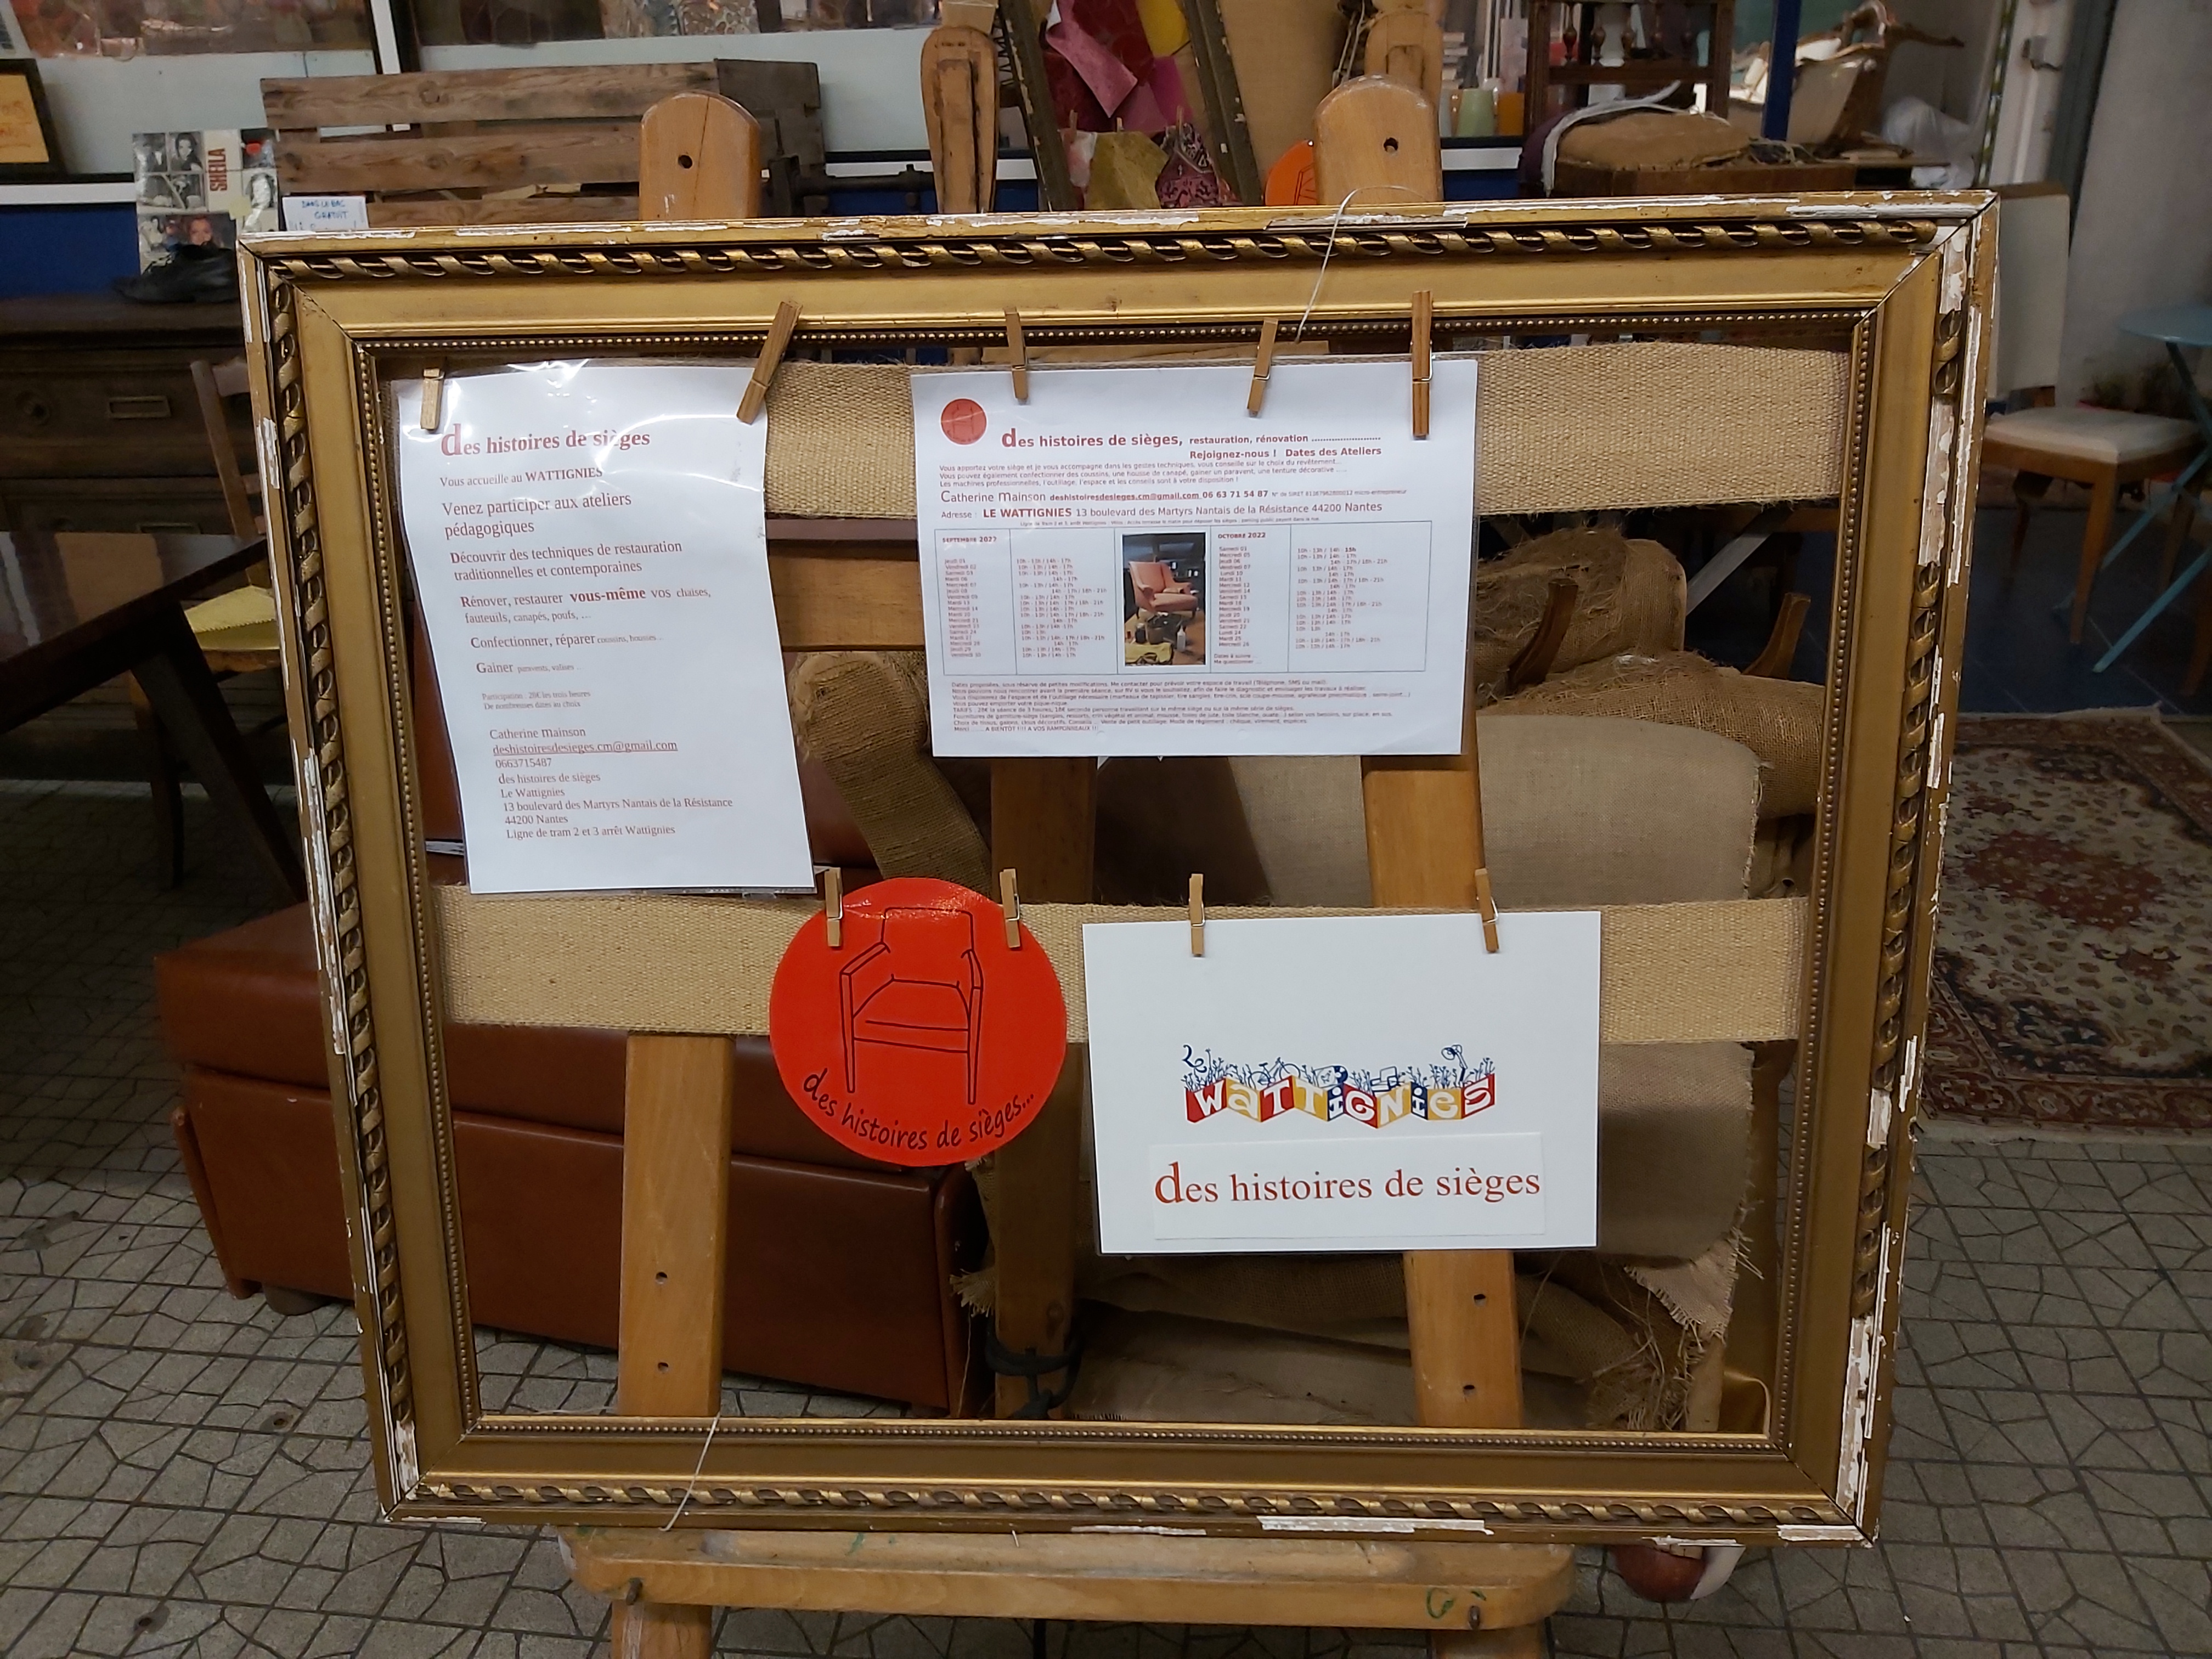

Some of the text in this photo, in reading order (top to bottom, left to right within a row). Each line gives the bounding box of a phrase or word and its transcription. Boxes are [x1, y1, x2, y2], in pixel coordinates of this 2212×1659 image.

[208, 148, 227, 191] SHEILA
[441, 423, 481, 456] des
[486, 433, 560, 454] histoires
[566, 430, 587, 448] de
[1001, 428, 1034, 448] des
[1040, 435, 1103, 447] histoires
[1108, 434, 1126, 445] de
[1131, 433, 1183, 447] sièges,
[1189, 435, 1252, 444] restauration,
[1190, 450, 1269, 459] Rejoignez-nous
[1340, 447, 1381, 455] Ateliers
[439, 477, 464, 486] Vous
[467, 473, 508, 486] accueille
[525, 467, 602, 481] WATTIGNIES
[941, 490, 994, 502] Catherine
[442, 493, 631, 517] Venez participer aux ateliers
[983, 509, 996, 517] LE
[1000, 507, 1071, 517] WATTIGNIES
[1076, 508, 1087, 516] 13
[1090, 507, 1135, 516] boulevard
[1158, 507, 1192, 516] Martyrs
[1233, 505, 1245, 514] de
[1259, 504, 1308, 513] Résistance
[1312, 504, 1341, 512] 44200
[1345, 502, 1382, 511] Nantes
[444, 521, 534, 540] pédagogiques
[450, 540, 682, 563] Découvrir des techniques de restauration
[454, 561, 642, 580] traditionnelles et contemporaines
[460, 588, 710, 607] Rénover, restaurer vous-même vos chaises,
[465, 610, 578, 623] fauteuils, canapés, poufs,
[470, 636, 552, 648] Confectionner,
[555, 633, 595, 647] réparer
[476, 663, 513, 673] Gainer
[489, 729, 538, 739] Catherine
[493, 740, 678, 756] deshistoiresdesieges.cm@gmail.com
[495, 758, 551, 768] 0663715487
[498, 772, 600, 784] des histoires de sièges
[500, 788, 565, 799] Le Wattignies
[504, 798, 732, 811] 13 boulevard des Martyrs Nantais de la Résistance
[505, 815, 568, 824] 44200 Nantes
[506, 829, 533, 840] Ligne
[536, 828, 547, 837] de
[573, 827, 579, 836] 2
[592, 827, 599, 836] 3
[602, 825, 622, 835] arrêt
[625, 825, 675, 836] Wattignies
[803, 1068, 837, 1116] des
[841, 1103, 928, 1150] histoires
[936, 1119, 961, 1148] de
[1154, 1161, 1541, 1204] des histoires de sièges
